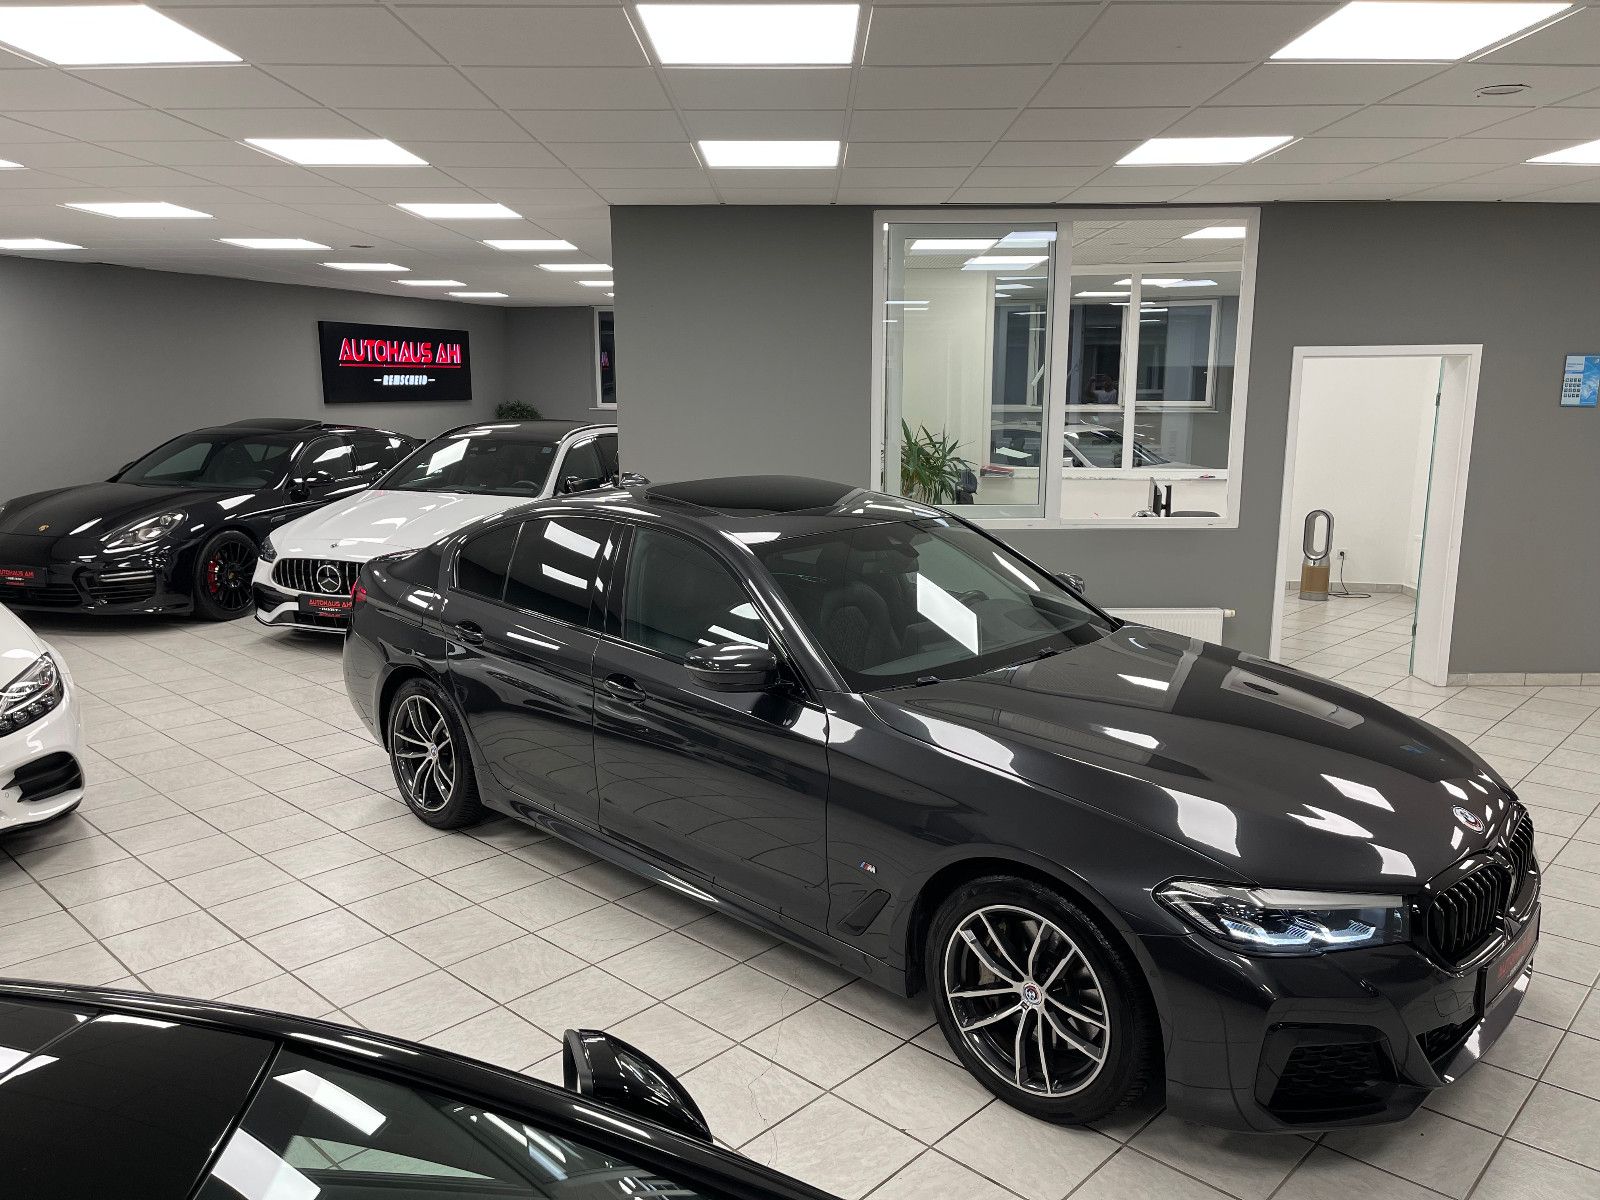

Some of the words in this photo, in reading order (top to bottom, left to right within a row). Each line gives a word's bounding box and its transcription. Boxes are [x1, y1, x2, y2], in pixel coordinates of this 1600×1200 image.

[338, 338, 433, 363] AUTOHAUS
[0, 569, 23, 577] UTOHAUS
[309, 599, 340, 607] AUTOHAUS
